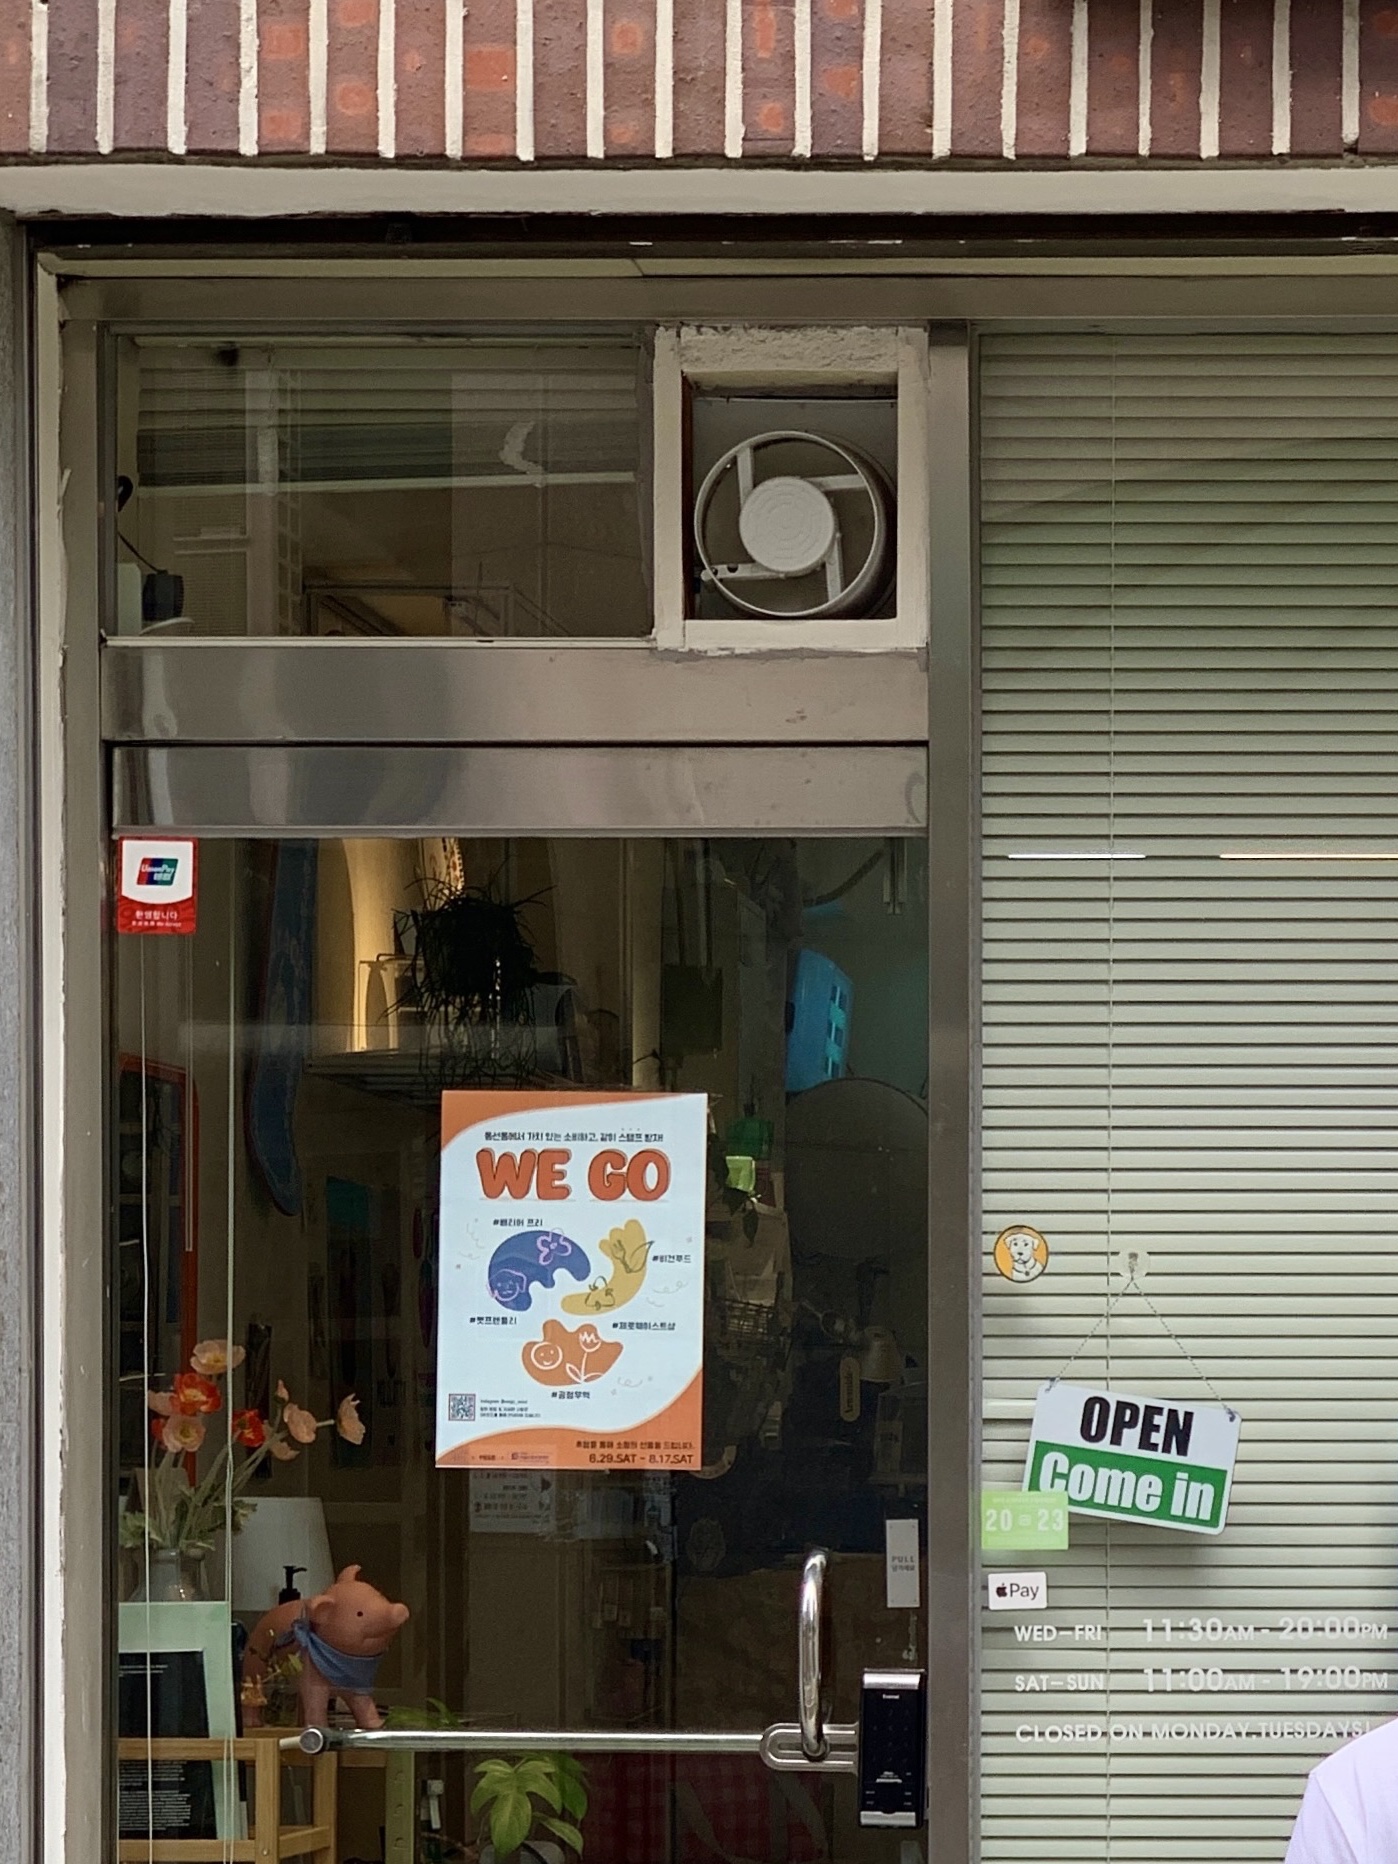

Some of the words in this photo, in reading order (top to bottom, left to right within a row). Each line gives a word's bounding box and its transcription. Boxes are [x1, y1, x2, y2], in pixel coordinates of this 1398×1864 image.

[476, 1147, 572, 1201] WE
[588, 1148, 671, 1202] GO
[1079, 1395, 1195, 1457] OPEN
[1039, 1450, 1164, 1513] Come
[1169, 1471, 1216, 1521] in
[984, 1508, 1014, 1533] 20
[1036, 1508, 1065, 1533] 23
[891, 1555, 915, 1563] PULL
[1009, 1582, 1040, 1600] Pay
[1142, 1616, 1255, 1642] 11:30AM
[1278, 1615, 1389, 1641] 20:00PM
[1143, 1667, 1256, 1692] 11:00AM
[1280, 1665, 1389, 1691] 19:00PM
[1015, 1723, 1101, 1743] CLOSED
[1109, 1722, 1144, 1741] ON
